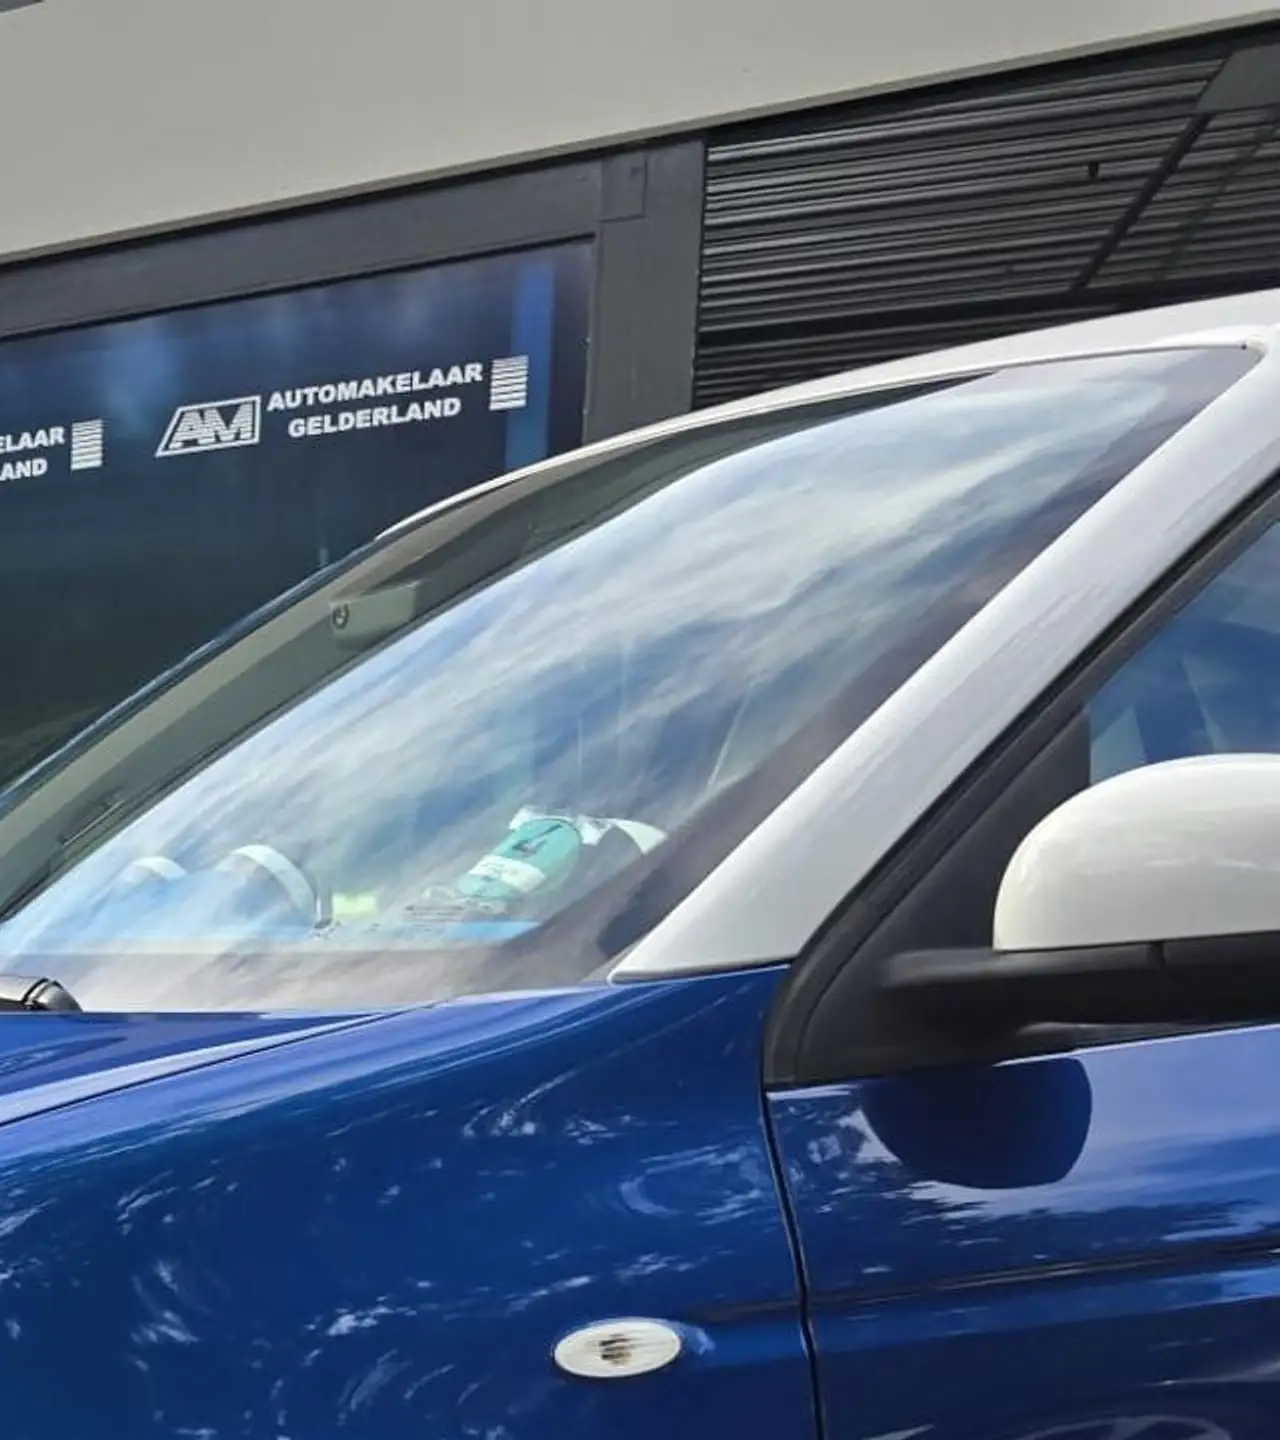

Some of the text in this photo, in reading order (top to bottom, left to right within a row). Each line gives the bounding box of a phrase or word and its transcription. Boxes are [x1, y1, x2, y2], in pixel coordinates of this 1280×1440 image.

[266, 362, 484, 411] AUTOMAKELAAR
[164, 402, 257, 451] AM
[288, 398, 461, 438] GELDERLAND
